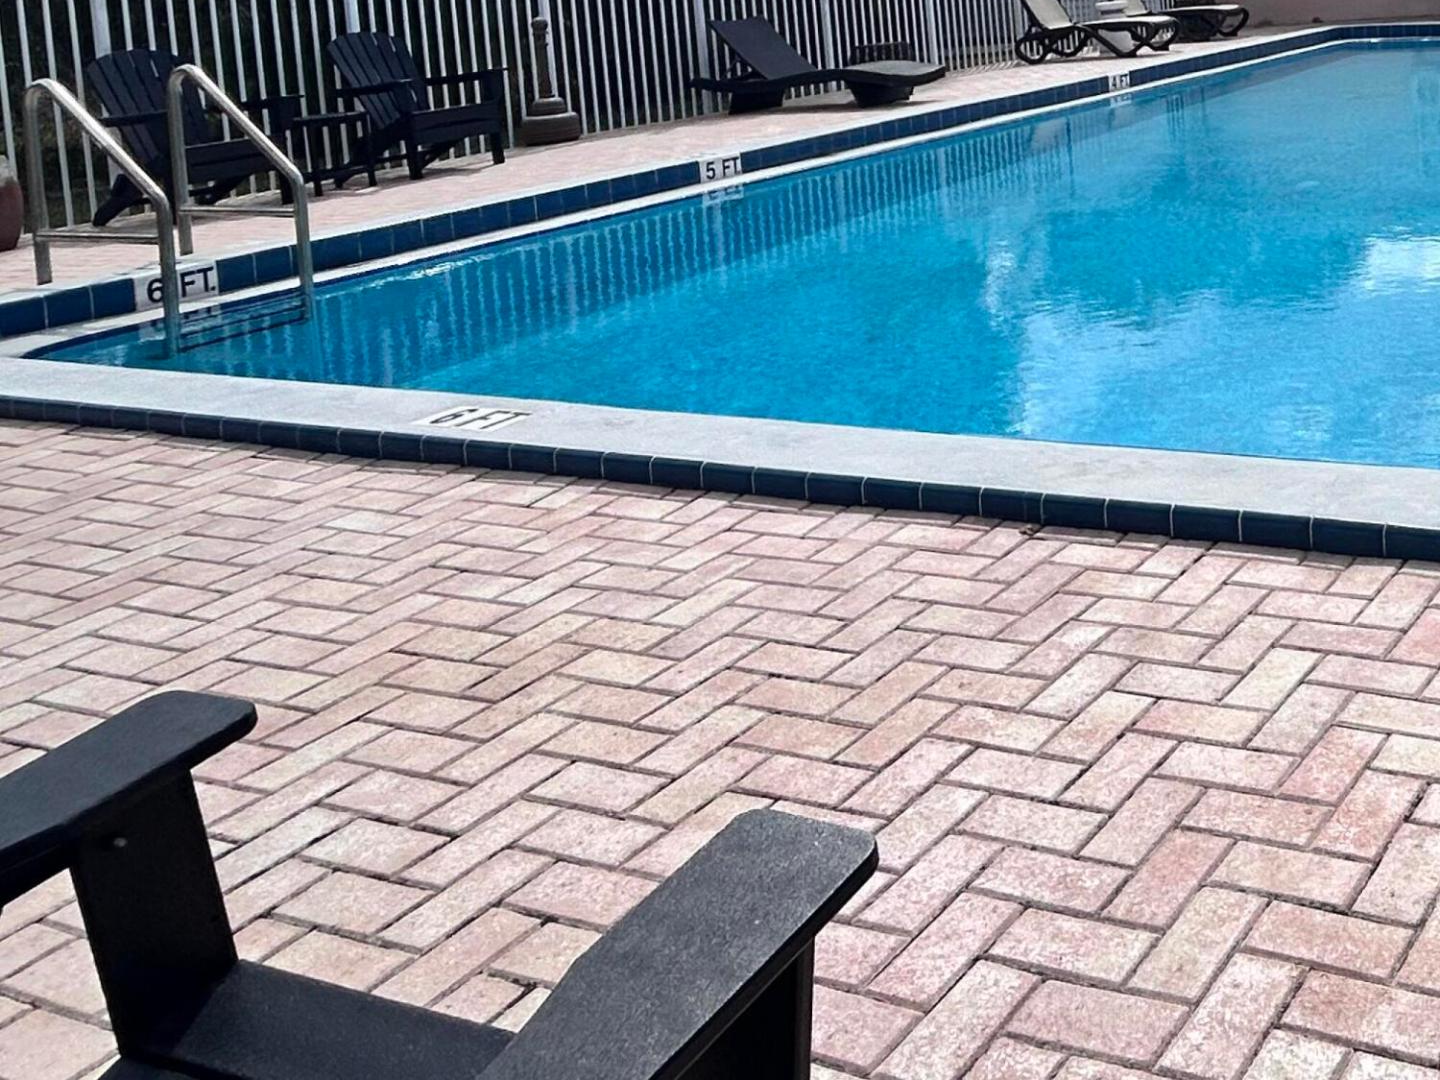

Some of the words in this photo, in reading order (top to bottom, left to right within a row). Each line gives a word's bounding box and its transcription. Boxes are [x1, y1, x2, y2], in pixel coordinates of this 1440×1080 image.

[706, 161, 716, 180] 5
[147, 278, 164, 303] 6
[180, 266, 217, 298] FT.
[429, 408, 480, 425] 6
[455, 409, 533, 430] FT
